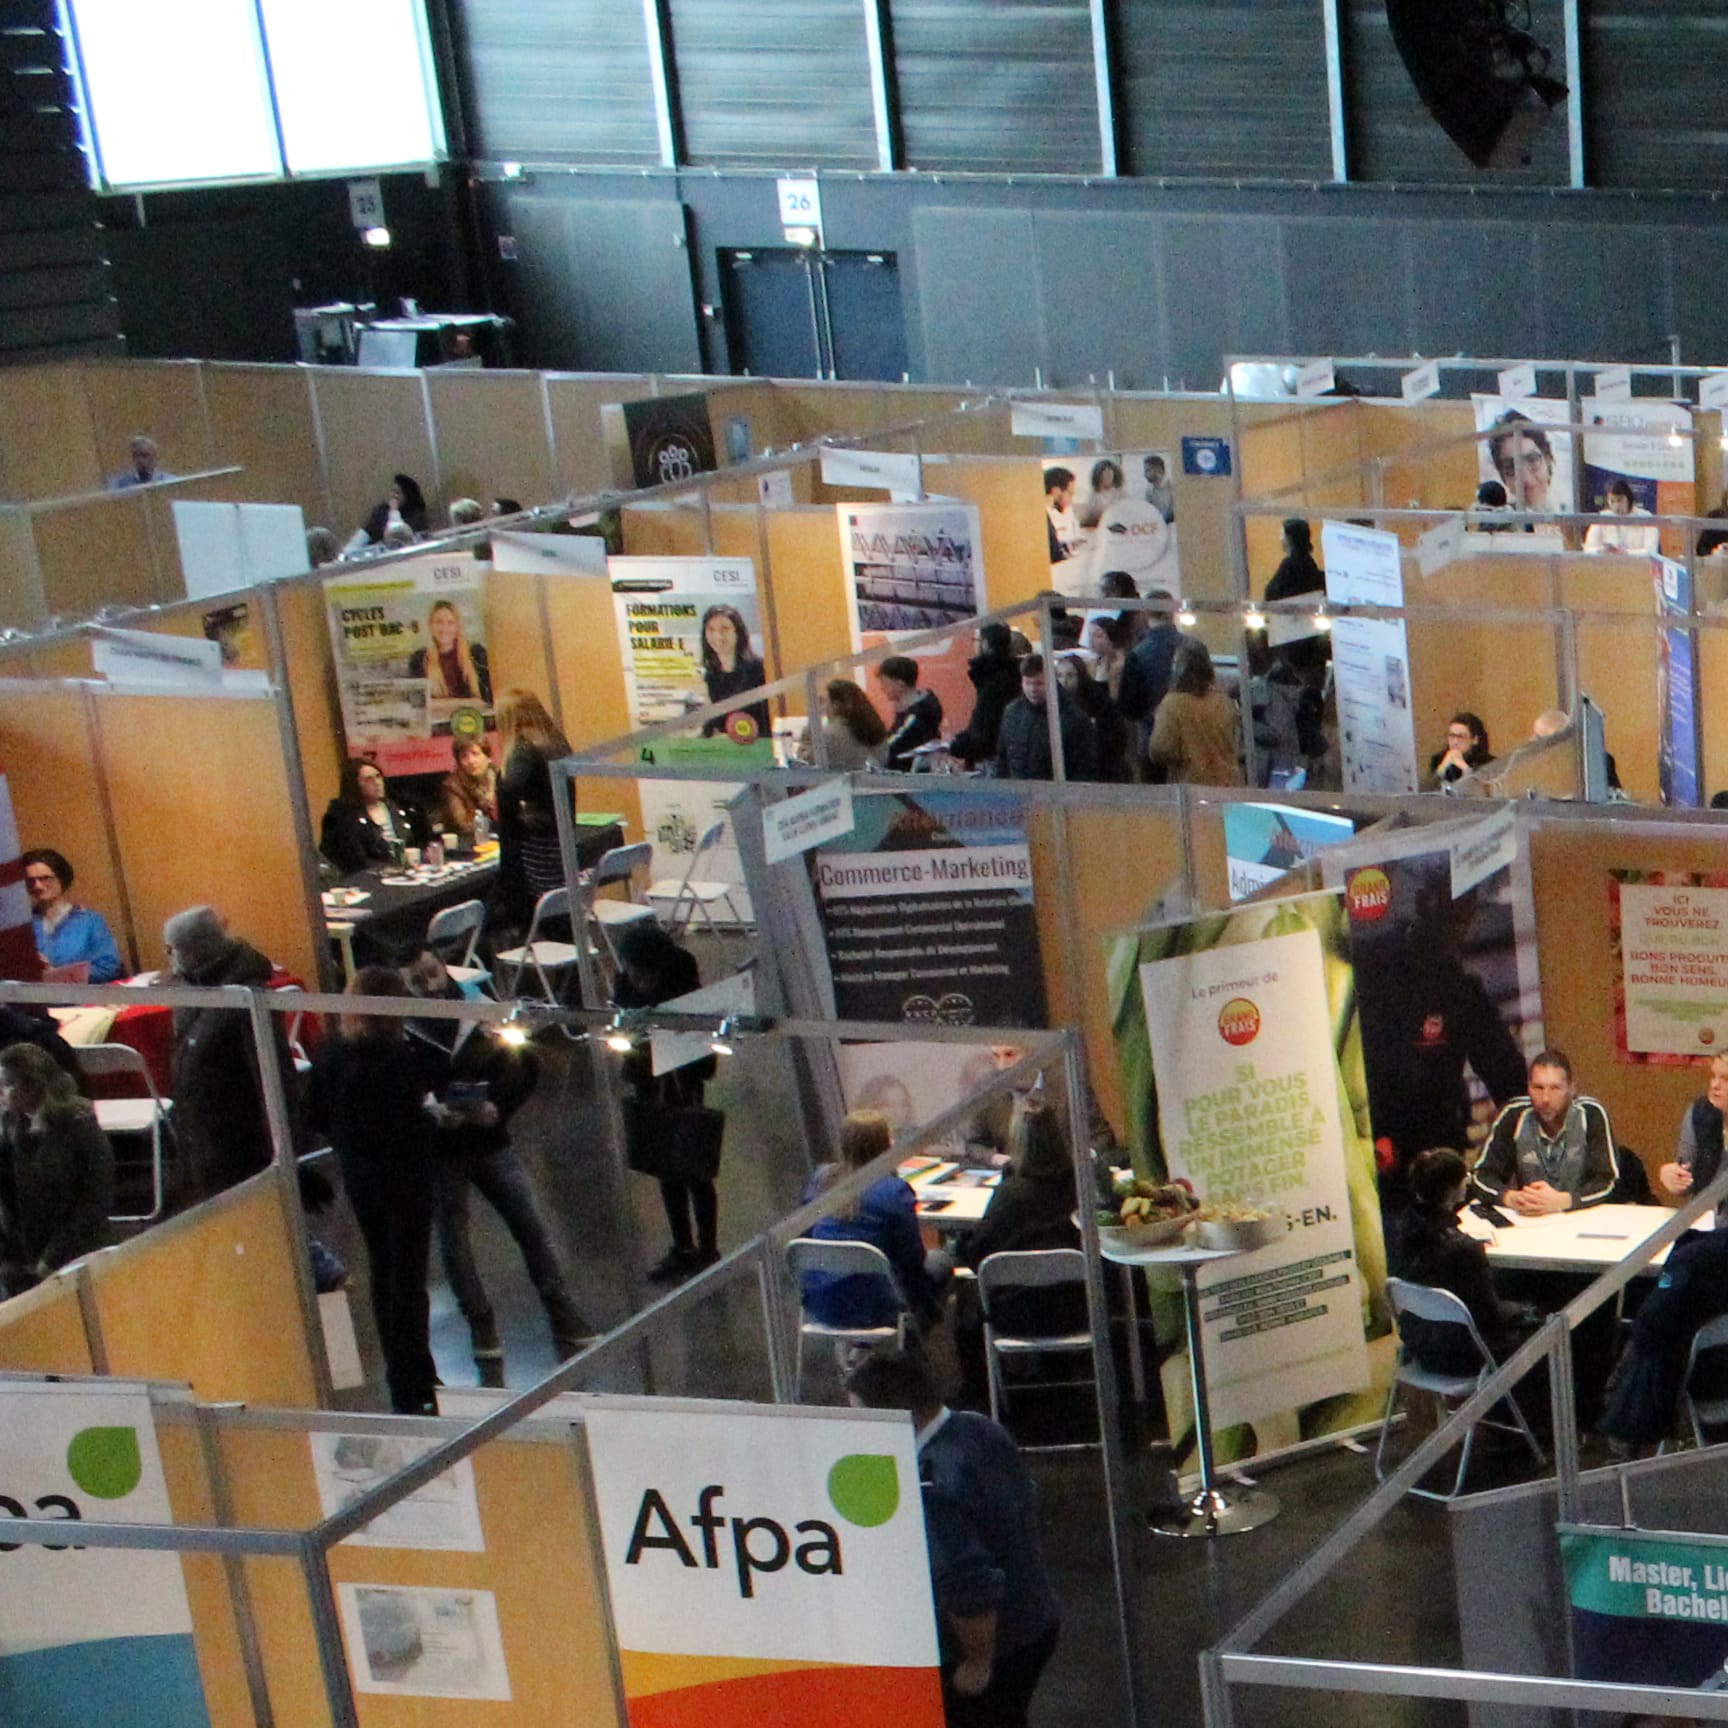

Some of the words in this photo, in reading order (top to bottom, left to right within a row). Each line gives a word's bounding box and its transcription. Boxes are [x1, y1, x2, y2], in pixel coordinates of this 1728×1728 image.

[788, 193, 811, 211] 26
[433, 567, 462, 580] CESI
[713, 570, 741, 583] CESI
[820, 855, 1030, 887] Commerce-Marketing
[1353, 891, 1389, 910] FRAIS
[1653, 906, 1689, 917] VOUS
[1644, 917, 1721, 930] TROUVEREZ
[1630, 973, 1676, 986] BONNE
[1223, 1020, 1257, 1036] FRAIS
[1182, 1086, 1245, 1115] POUR
[1248, 1071, 1308, 1096] VOUS
[1186, 1114, 1211, 1138] LE
[1214, 1092, 1310, 1128] PARADIS
[1180, 1115, 1304, 1158] RESSEMBLE
[1185, 1154, 1210, 1178] UN
[1213, 1132, 1322, 1172] IMMENSE
[1205, 1150, 1308, 1190] POTAGER
[624, 1486, 844, 1599] Afpa
[1608, 1555, 1698, 1593] Master,
